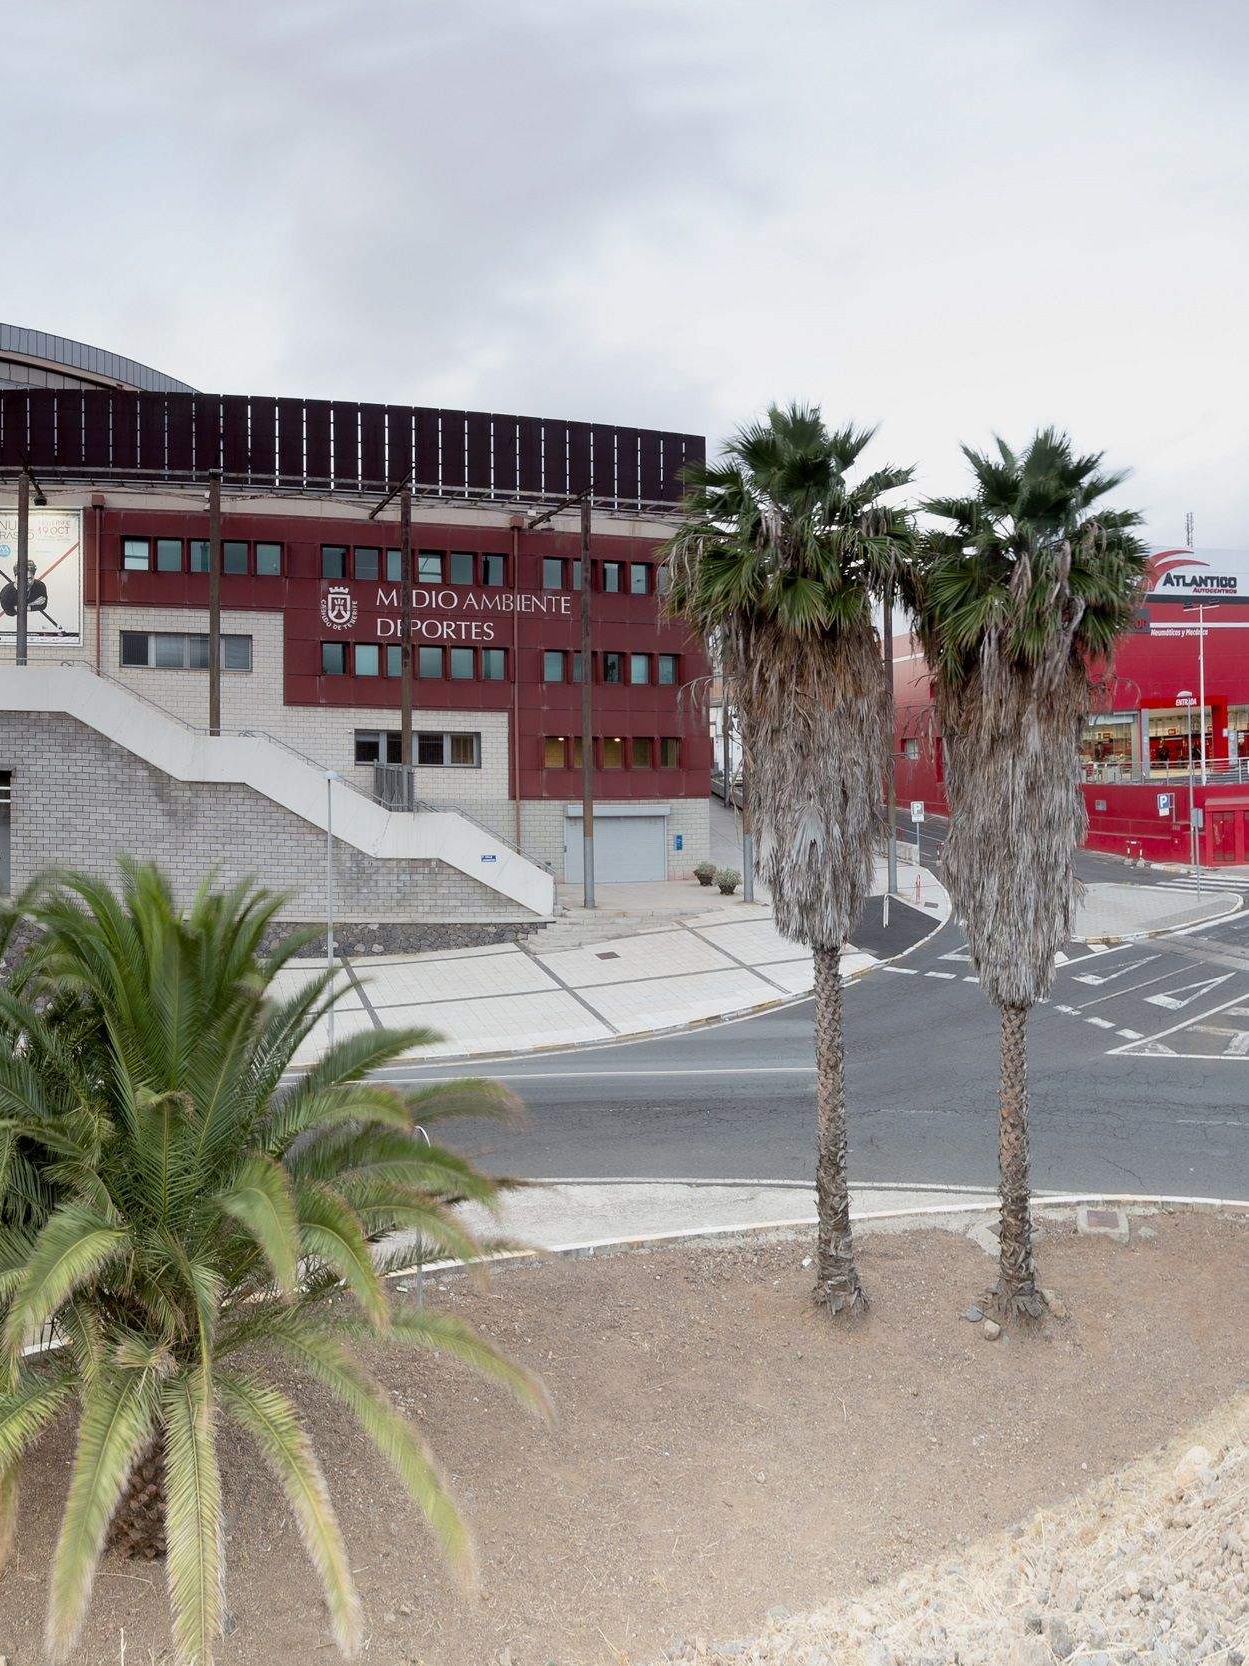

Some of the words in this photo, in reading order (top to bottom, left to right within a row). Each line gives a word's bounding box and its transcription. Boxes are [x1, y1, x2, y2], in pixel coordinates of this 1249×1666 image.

[38, 526, 48, 534] 19
[50, 526, 71, 535] OCT
[1192, 586, 1238, 594] AUTOCENTROS
[376, 588, 458, 610] MDIO
[462, 592, 572, 614] AMBIENTE
[320, 599, 332, 628] CABILDO
[342, 600, 358, 630] TENERIFE
[1185, 628, 1209, 636] Mecánca
